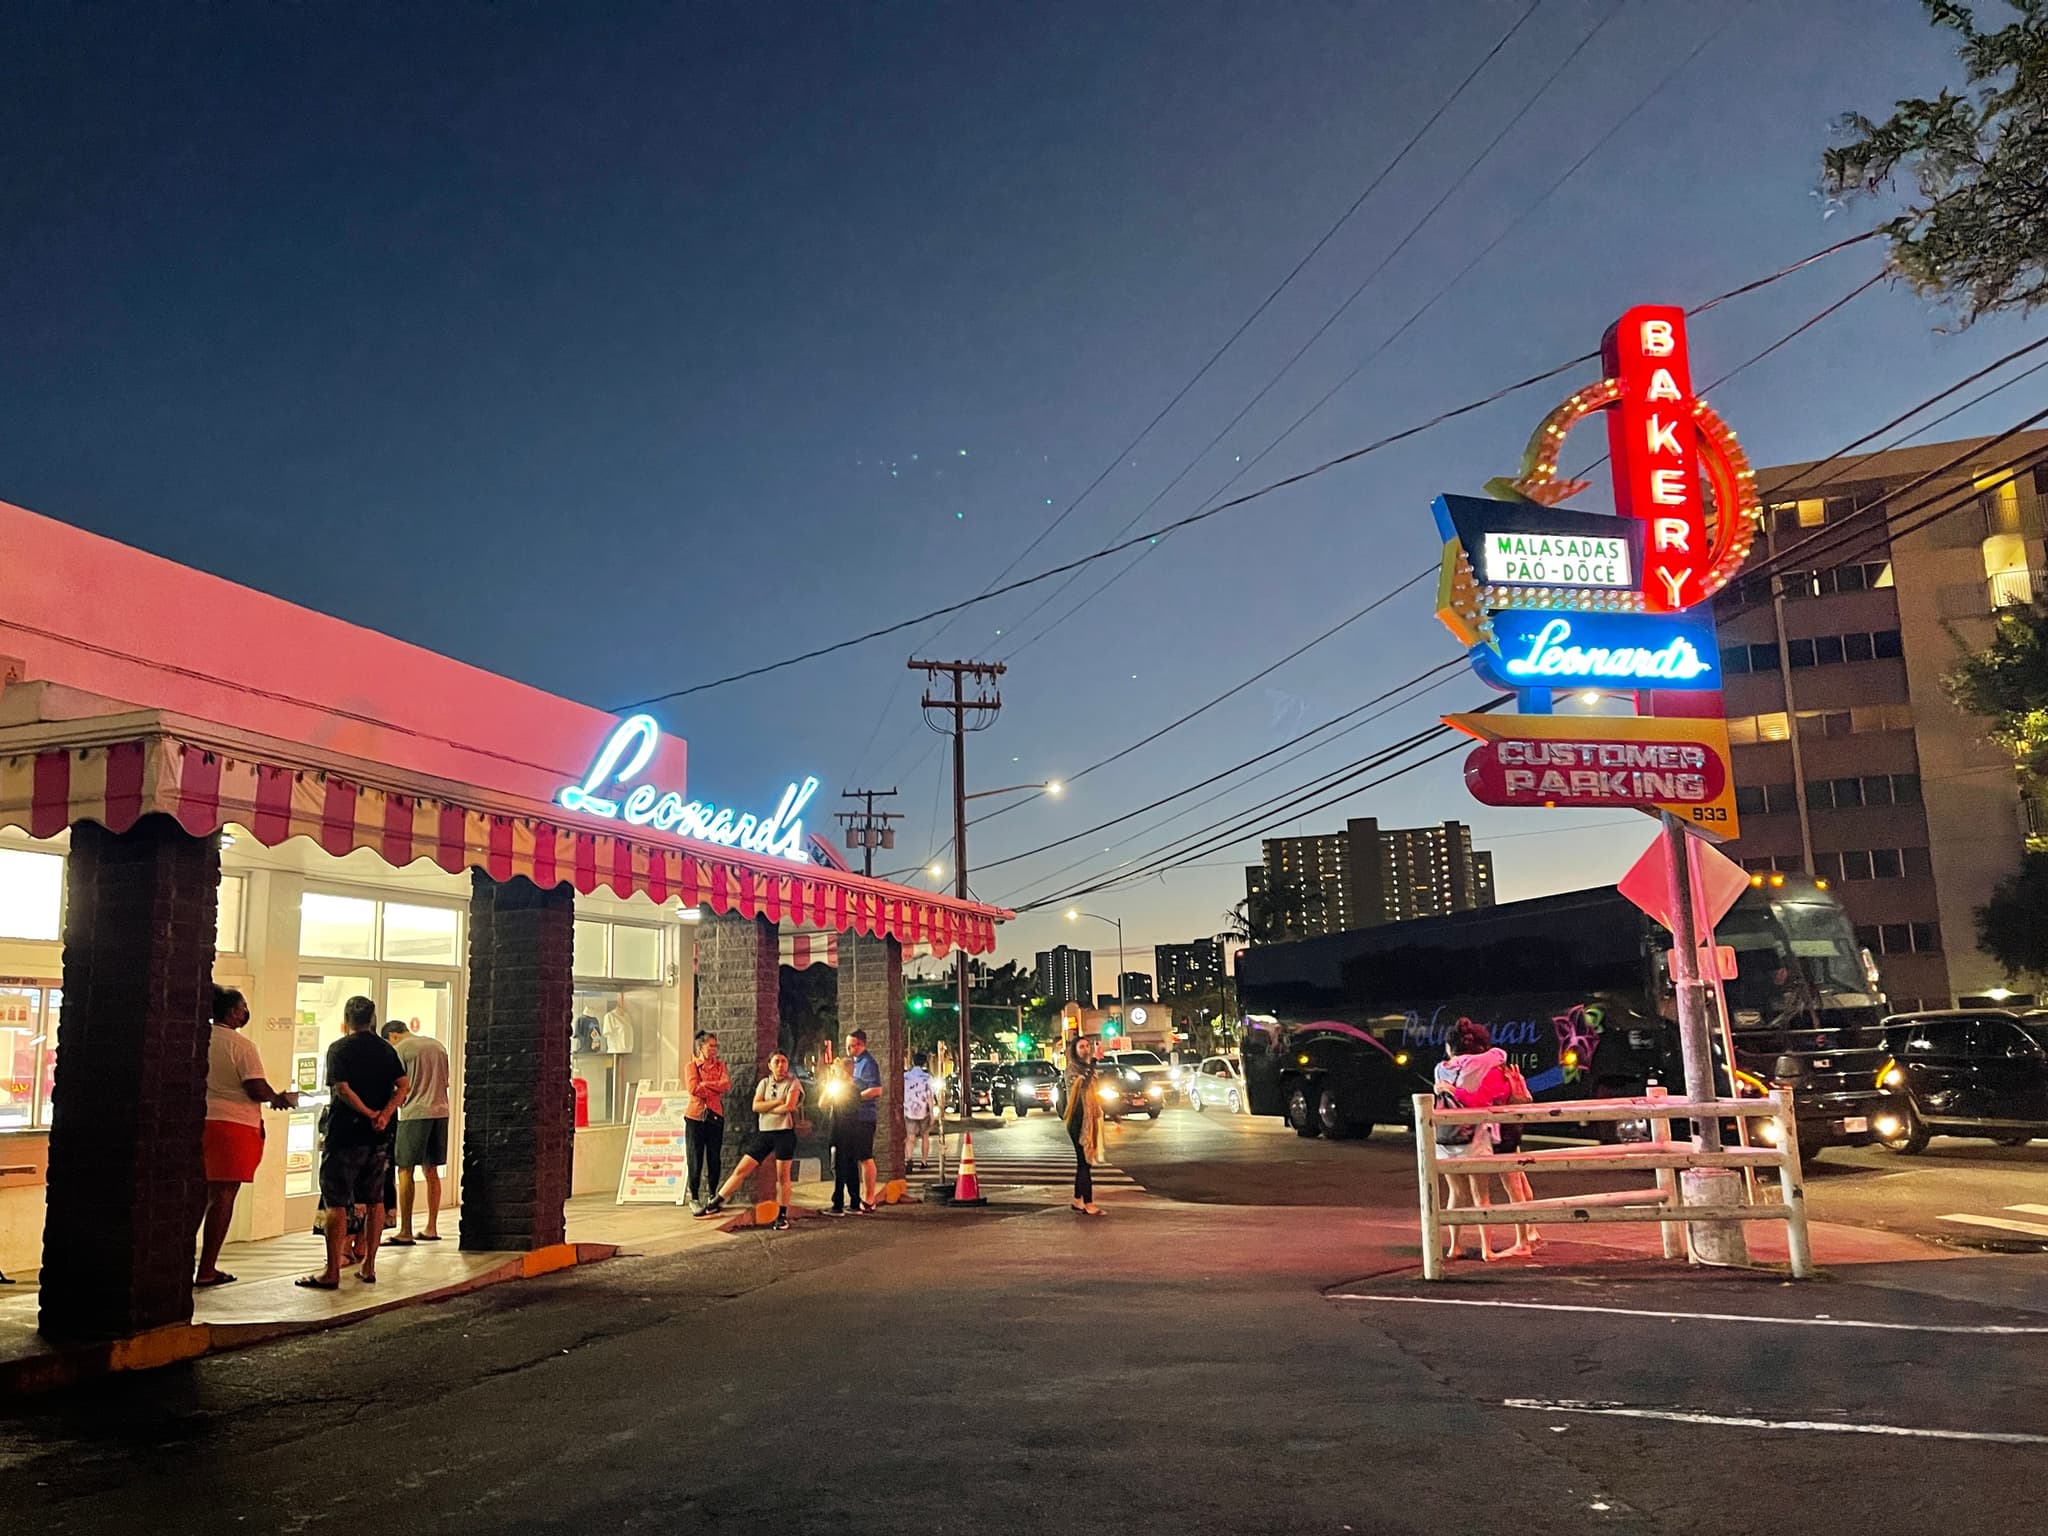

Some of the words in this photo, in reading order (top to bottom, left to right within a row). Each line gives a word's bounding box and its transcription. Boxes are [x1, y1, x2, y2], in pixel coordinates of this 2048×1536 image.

[1640, 320, 1692, 608] BAKERY
[1497, 537, 1619, 559] MALASADAS
[1498, 741, 1705, 768] CUSTOMER
[560, 713, 820, 864] Leonard's
[1504, 769, 1705, 800] PARKING
[1693, 807, 1727, 821] 933
